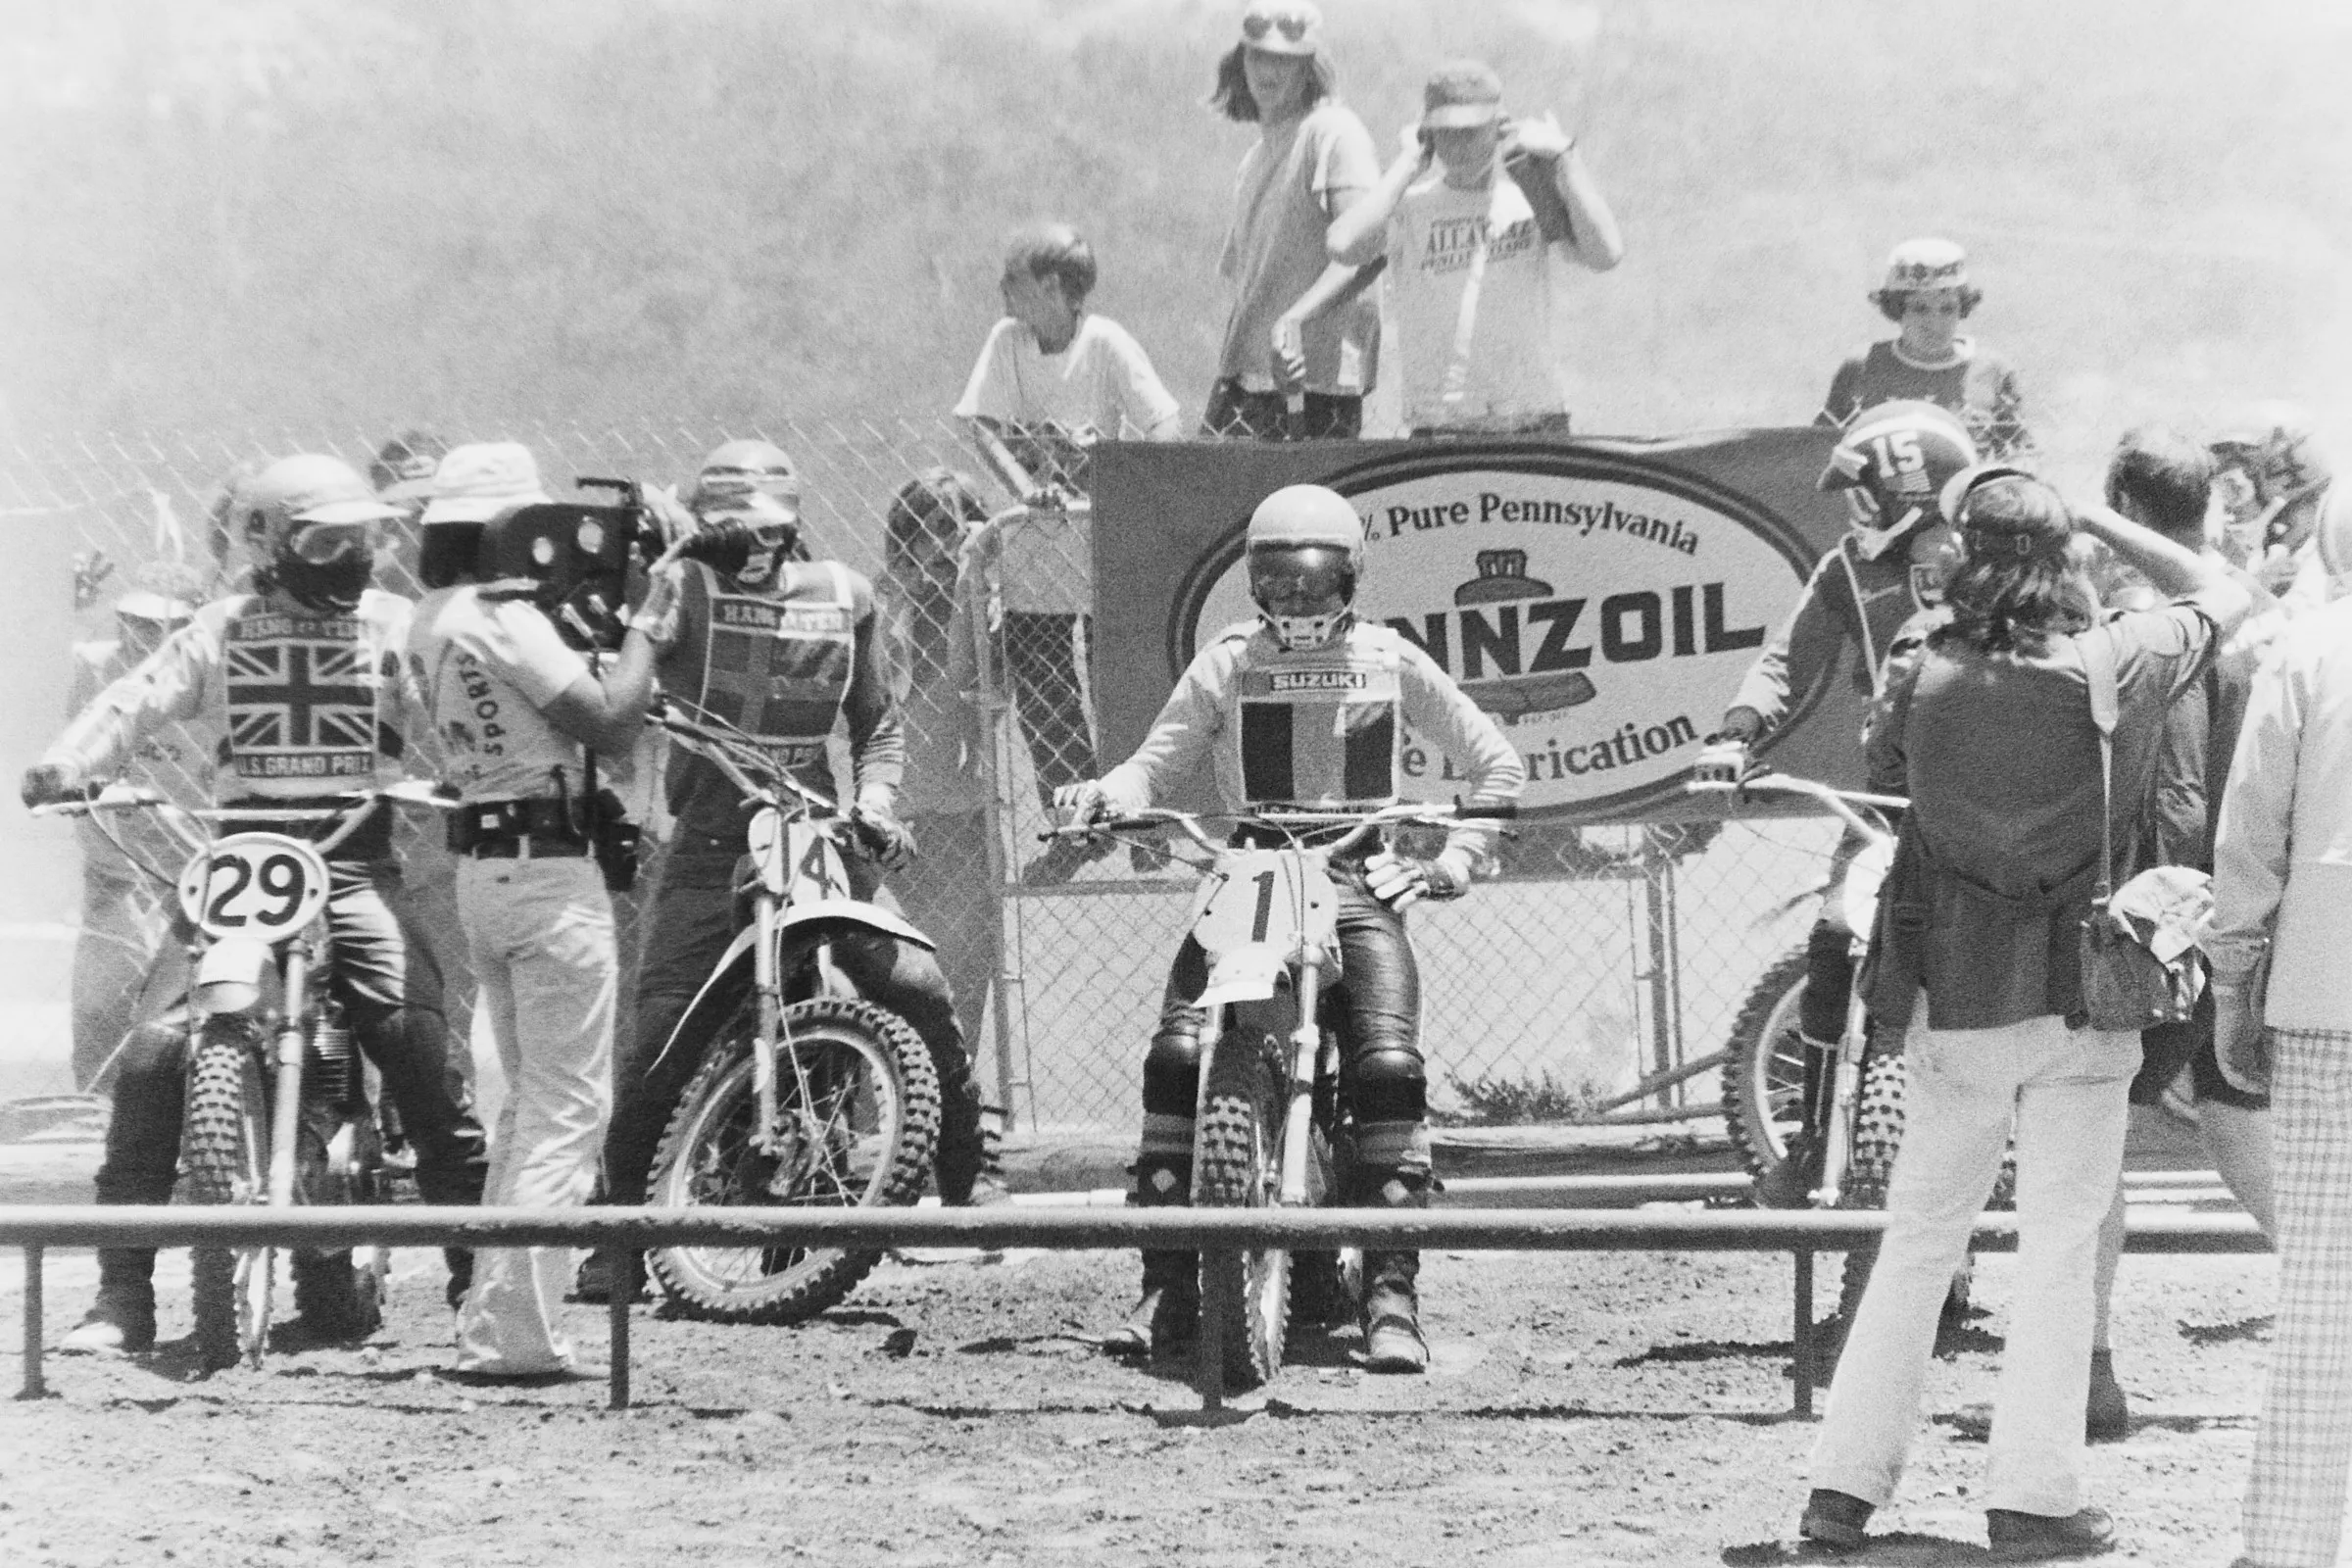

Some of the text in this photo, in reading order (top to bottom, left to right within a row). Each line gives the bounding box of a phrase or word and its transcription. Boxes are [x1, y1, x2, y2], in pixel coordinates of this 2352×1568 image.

[1873, 430, 1926, 479] 15
[1387, 505, 1470, 537] Pure
[1479, 492, 1699, 557] Pennsylvania
[1383, 581, 1767, 681] NNZOIL
[455, 652, 508, 757] SPORTS
[1273, 672, 1363, 688] SUZUKI
[207, 854, 306, 927] 29
[1251, 870, 1275, 943] 1
